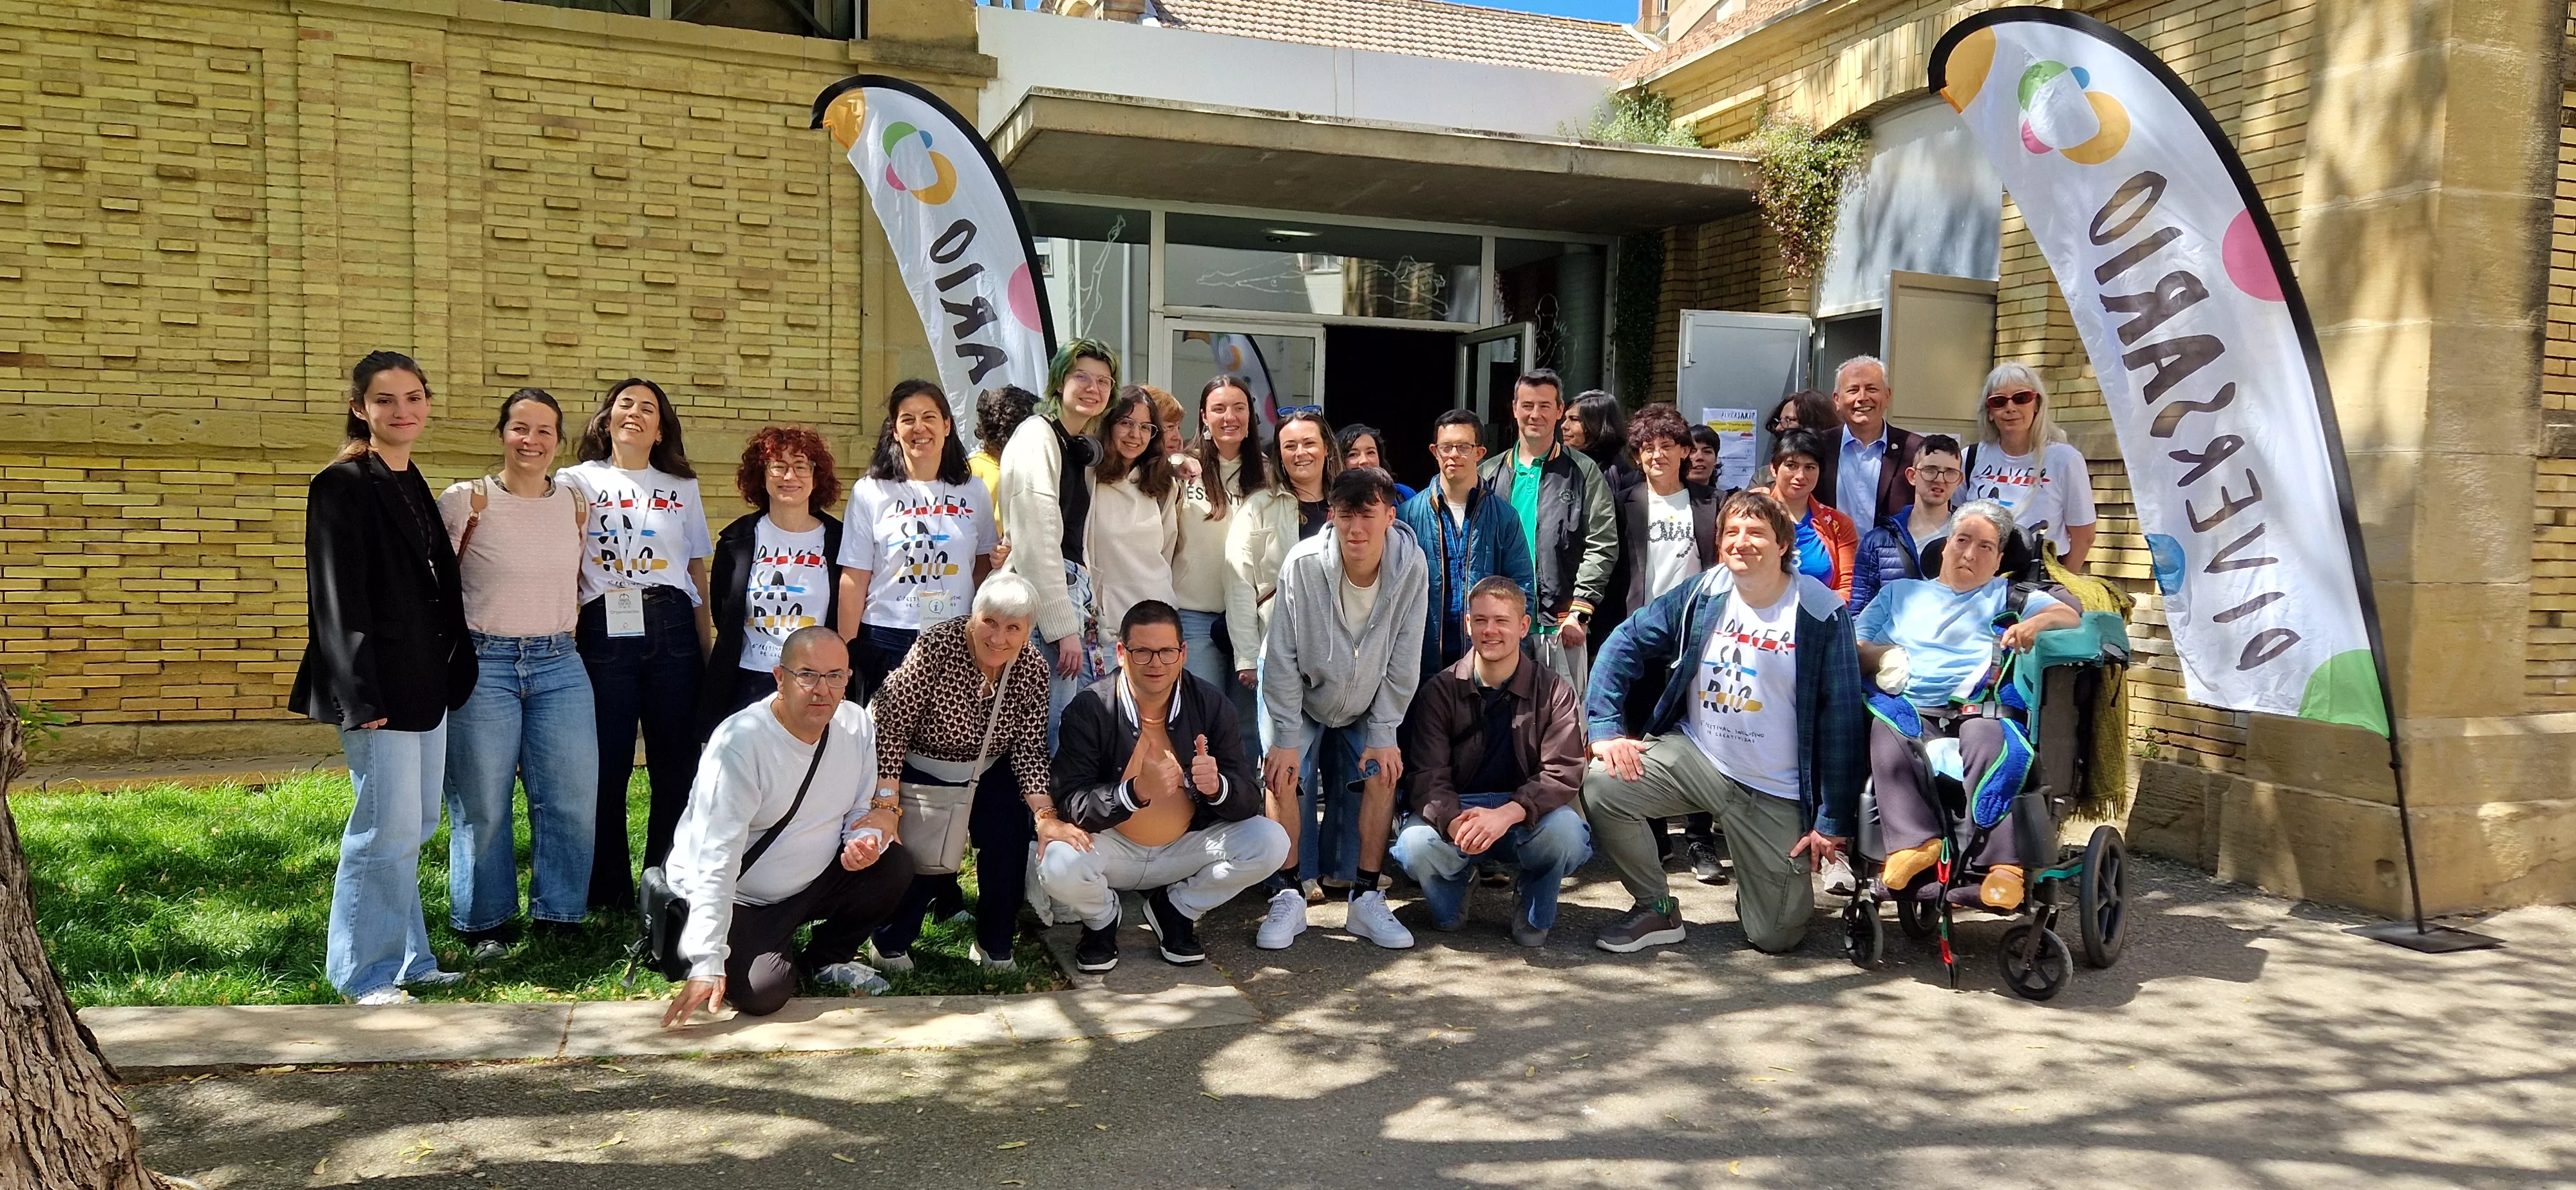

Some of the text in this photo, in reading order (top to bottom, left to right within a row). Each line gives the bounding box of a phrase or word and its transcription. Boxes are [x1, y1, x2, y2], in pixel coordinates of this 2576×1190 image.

[895, 495, 970, 520] DIVER
[902, 520, 934, 551] SA
[898, 551, 949, 585] RIO
[752, 571, 788, 602] SA
[753, 603, 803, 636] RIO
[1712, 645, 1741, 682] SA
[1703, 679, 1752, 713] RIO
